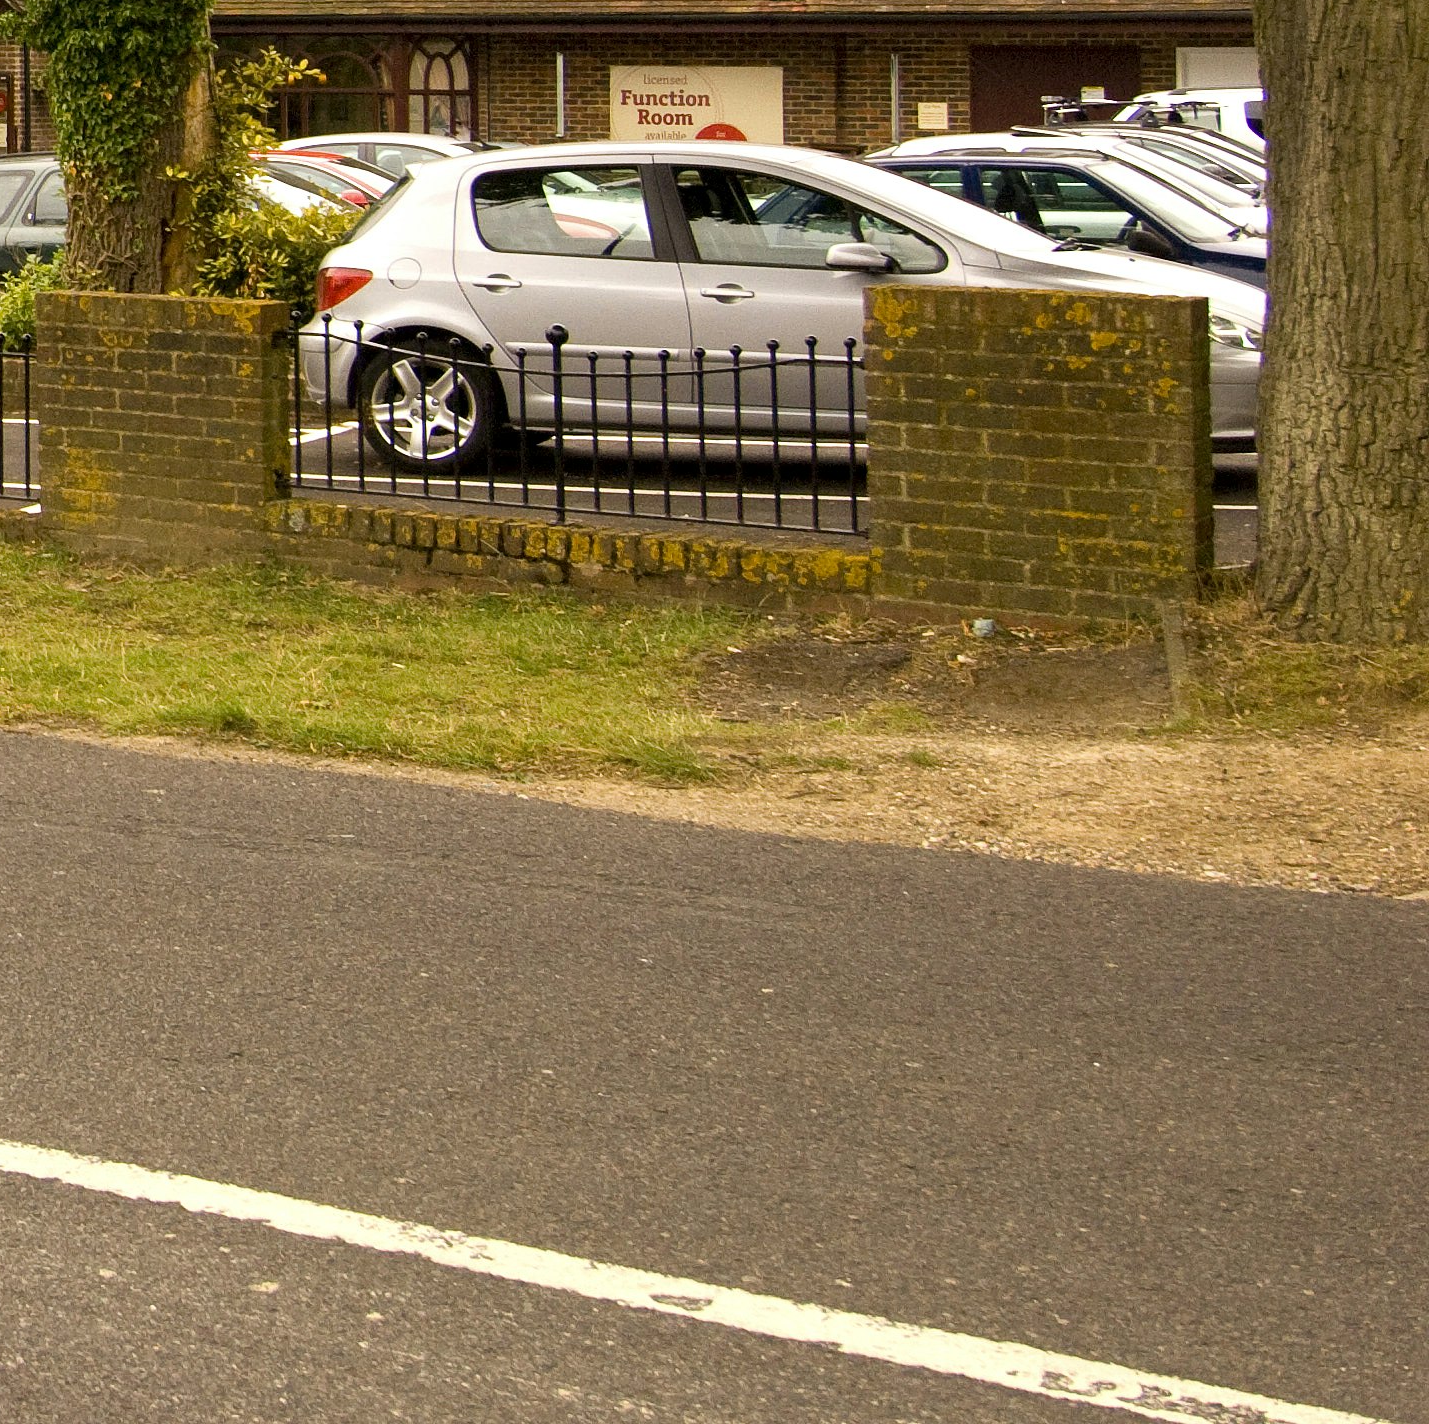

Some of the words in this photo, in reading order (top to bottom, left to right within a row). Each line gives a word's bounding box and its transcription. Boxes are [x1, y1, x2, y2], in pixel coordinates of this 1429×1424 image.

[643, 74, 688, 85] licensed
[620, 89, 711, 107] Function
[637, 109, 694, 126] Room
[644, 130, 687, 141] available
